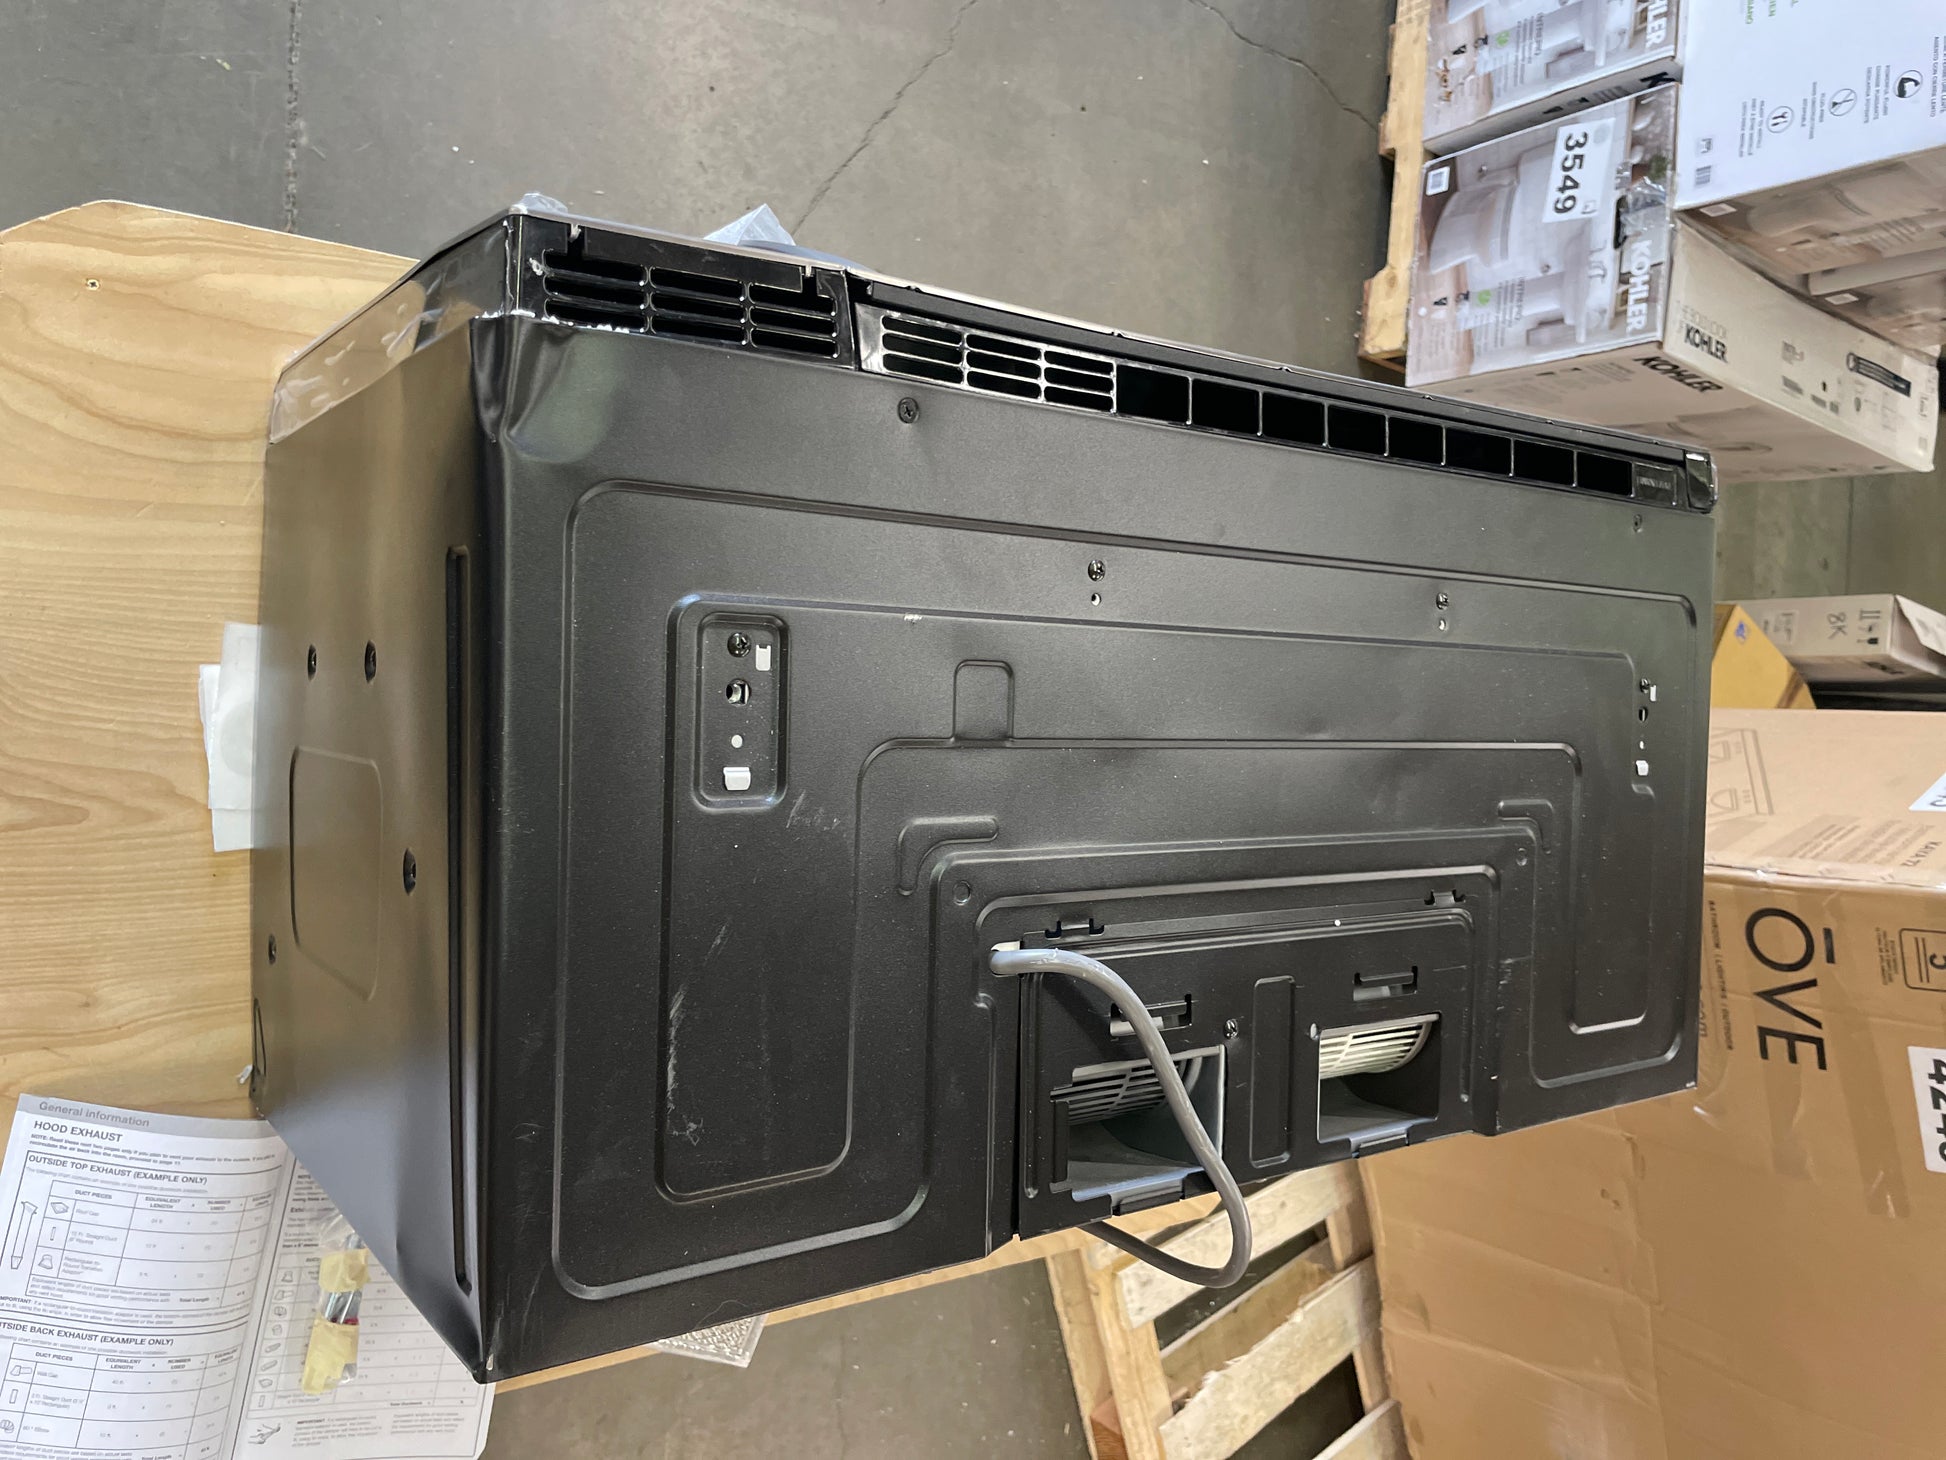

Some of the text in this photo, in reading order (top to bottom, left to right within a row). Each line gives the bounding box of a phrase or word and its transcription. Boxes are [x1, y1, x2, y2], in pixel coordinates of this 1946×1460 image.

[1554, 132, 1588, 214] 3549
[1626, 240, 1652, 334] KOHLER
[1684, 322, 1728, 363] KOHLER
[1632, 356, 1724, 393] KOHLER
[34, 1120, 124, 1142] HOOD EXHAUST
[39, 1102, 150, 1127] General information
[28, 1154, 69, 1168] OUTSIDE
[70, 1162, 88, 1170] TOP
[90, 1166, 132, 1178] EXHAUST
[133, 1171, 178, 1183] (EXAMPLE
[181, 1176, 208, 1185] ONLY)
[30, 1326, 55, 1336] BACK
[57, 1330, 99, 1342] EXHAUST
[100, 1336, 146, 1346] (EXAMPLE
